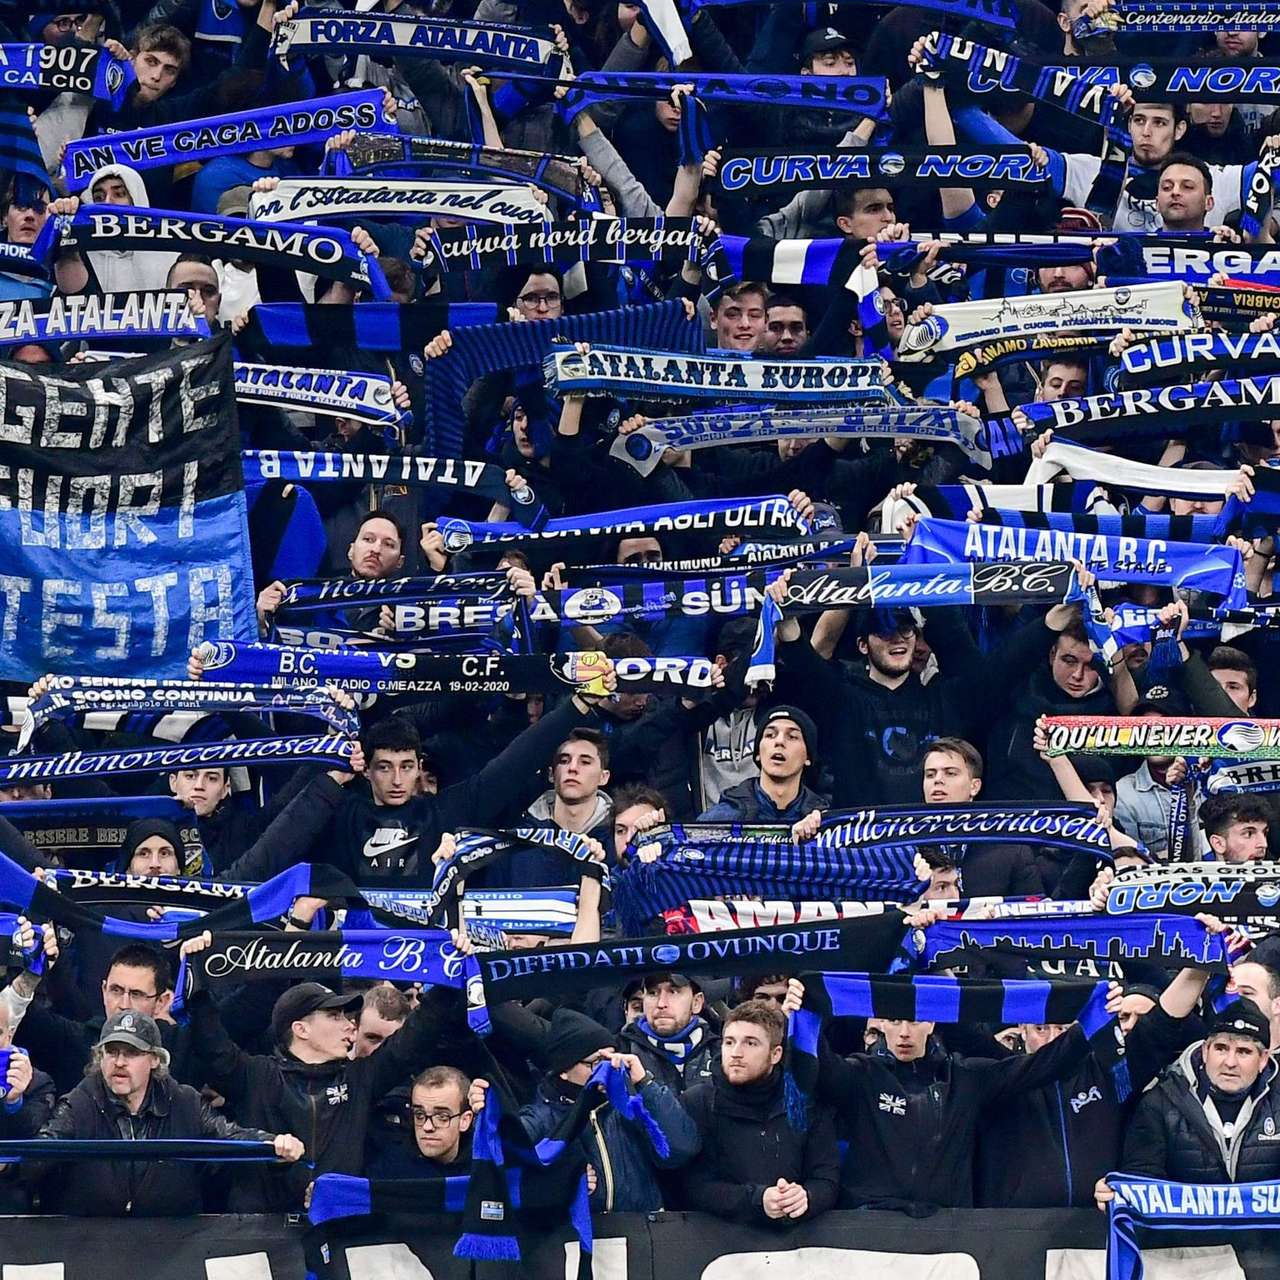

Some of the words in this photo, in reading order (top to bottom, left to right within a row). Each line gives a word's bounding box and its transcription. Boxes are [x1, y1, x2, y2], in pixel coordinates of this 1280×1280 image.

[40, 42, 97, 74] 1907
[310, 20, 395, 46] FORZA
[408, 25, 541, 61] ATALANTA
[125, 138, 166, 170] VE
[721, 153, 871, 190] CURVA
[917, 151, 1050, 180] NORD
[439, 188, 487, 211] nel
[91, 214, 345, 264] BERGAMO
[441, 234, 520, 260] curva
[529, 221, 596, 249] nord
[45, 291, 197, 334] ATALANTA
[587, 347, 749, 387] ATALANTA
[964, 524, 1109, 560] ATALANTA
[0, 564, 234, 660] TESTA
[278, 652, 320, 675] B.C.
[462, 656, 505, 677] C.F.
[143, 690, 255, 702] CONTINUA
[272, 675, 320, 688] MILANO
[325, 678, 371, 690] STADIO
[377, 679, 442, 692] G.MEAZZA
[448, 679, 510, 692] 19-02-2020
[1129, 724, 1210, 749] NEVER
[1108, 880, 1245, 915] NORD
[205, 940, 364, 977] Atalanta
[486, 947, 645, 982] DIFFIDATI
[687, 928, 841, 961] OVUNQUE
